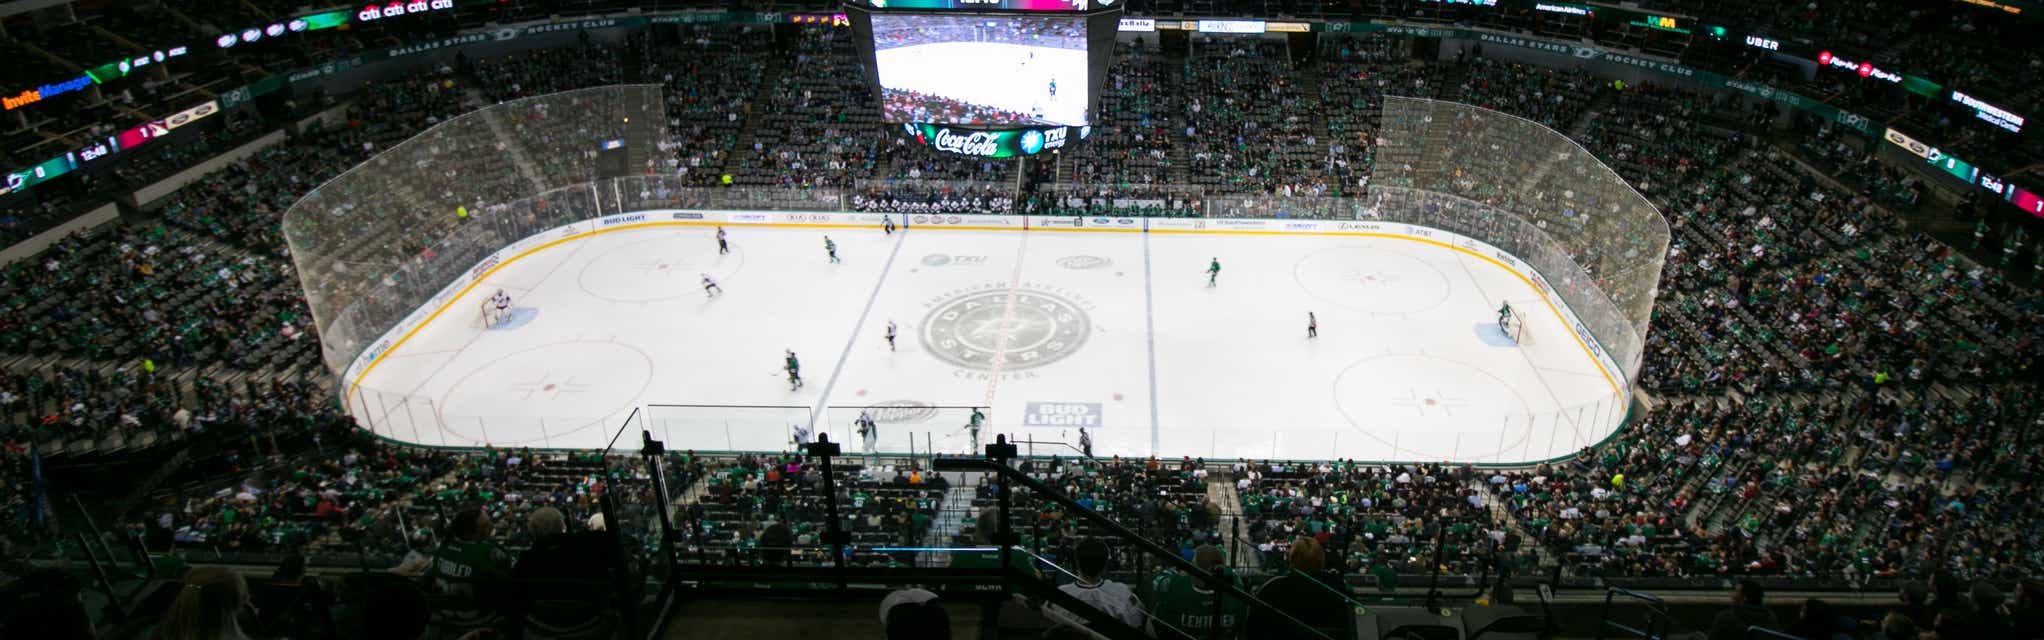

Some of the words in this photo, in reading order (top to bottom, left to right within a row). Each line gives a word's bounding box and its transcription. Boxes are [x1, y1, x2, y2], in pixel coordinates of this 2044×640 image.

[359, 9, 381, 21] citi
[383, 5, 405, 17] citi
[407, 1, 428, 13] citi
[389, 41, 440, 57] DALLAS
[443, 34, 485, 48] STARS
[527, 23, 577, 34] HOCKEY
[583, 19, 615, 28] CLUB
[1746, 36, 1779, 51] UBER
[1480, 34, 1525, 46] DALLAS
[1527, 41, 1567, 53] STARS
[1605, 54, 1656, 68] HOCKEY
[1660, 64, 1693, 77] CLUB
[1043, 127, 1066, 142] TXU
[934, 129, 999, 157] Coca-Cola
[1043, 139, 1063, 150] energy
[603, 216, 621, 225] BUD
[622, 214, 645, 223] LIGHT
[1573, 322, 1601, 358] GEICO
[1037, 404, 1090, 415] BUD
[1026, 414, 1099, 427] LIGHT
